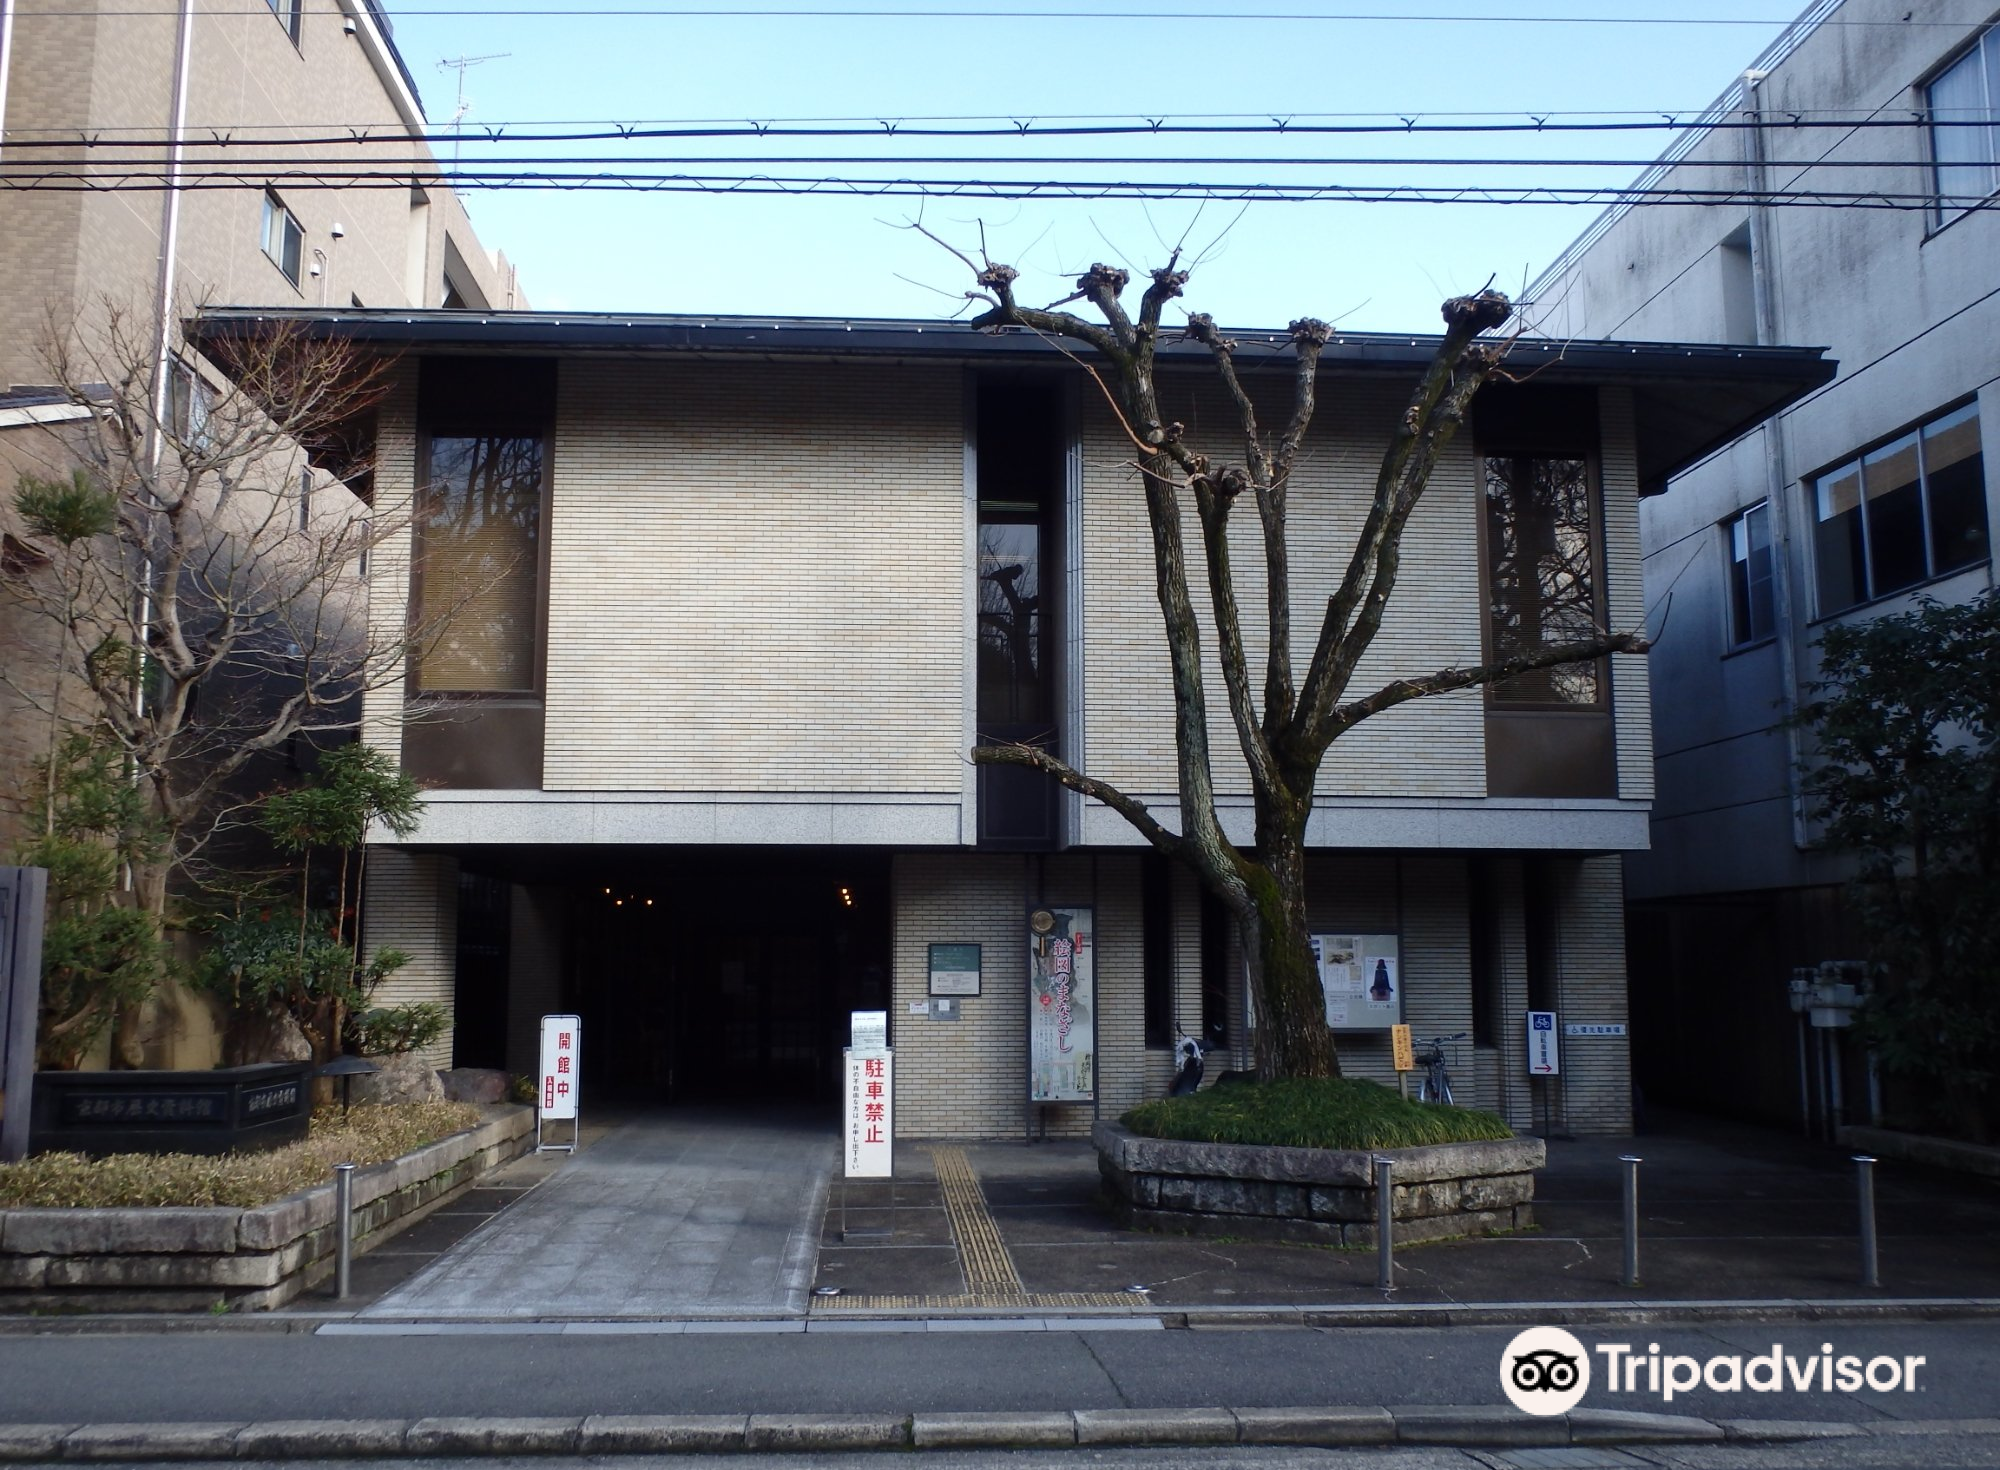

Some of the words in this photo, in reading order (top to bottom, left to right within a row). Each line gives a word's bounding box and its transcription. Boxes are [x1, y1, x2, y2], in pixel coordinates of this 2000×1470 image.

[1053, 938, 1072, 1053] 絵図のまなざし
[557, 1032, 571, 1098] 開館中
[864, 1058, 885, 1144] 駐車禁止
